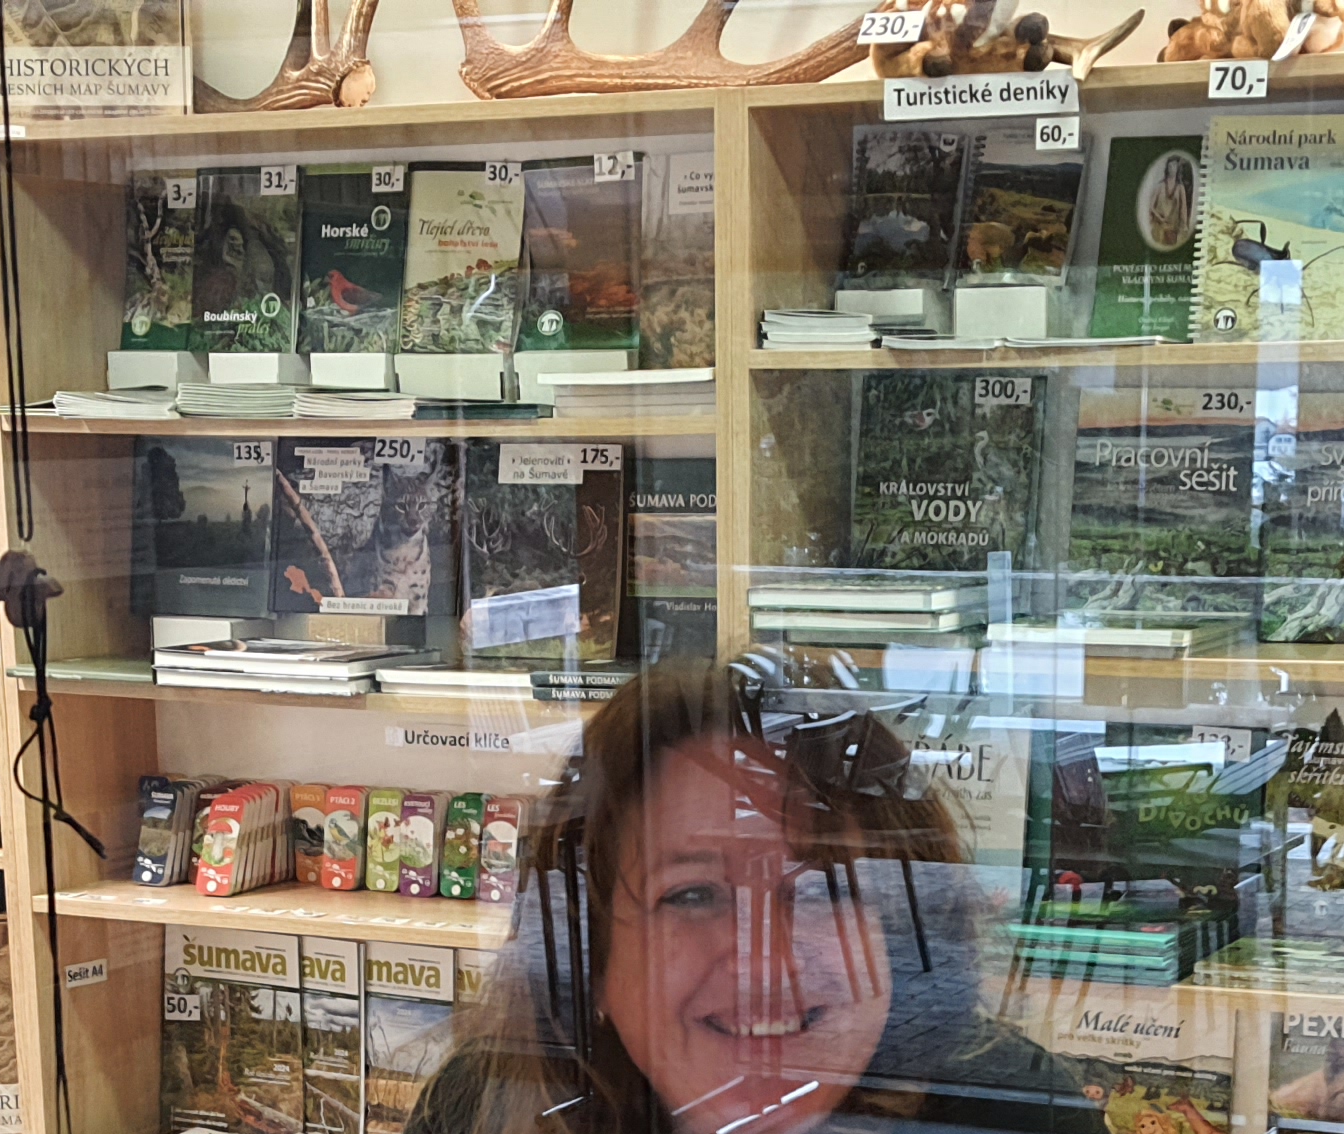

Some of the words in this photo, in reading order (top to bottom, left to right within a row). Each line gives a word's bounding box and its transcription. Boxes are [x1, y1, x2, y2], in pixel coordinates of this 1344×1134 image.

[861, 16, 919, 38] 230,-
[3, 54, 170, 78] HISTORICKÝCH
[106, 80, 170, 96] ŠUMAVY
[1214, 66, 1266, 95] 70,-
[893, 83, 992, 107] Turistické
[999, 80, 1069, 104] deníky
[1039, 125, 1074, 144] 60,-
[1225, 130, 1294, 147] Národní
[1298, 129, 1337, 149] park
[595, 155, 633, 179] 12,-
[1223, 148, 1311, 171] Šumava
[263, 171, 296, 192] 31,-
[374, 171, 401, 189] 30,-
[487, 164, 520, 185] 30,-
[321, 223, 368, 239] Horské
[978, 379, 1029, 402] 300,-
[1202, 393, 1252, 413] 230,-
[235, 444, 271, 464] 135,-
[376, 439, 423, 462] 250,-
[580, 448, 620, 468] 175,-
[1095, 440, 1210, 468] Pracovní
[879, 479, 970, 497] KRÁLOVSTVÍ
[1179, 464, 1238, 492] sešit
[629, 491, 686, 508] ŠUMAVA
[911, 500, 983, 522] VODY
[900, 532, 910, 544] A
[913, 529, 989, 546] MOKŘADŮ
[404, 730, 470, 748] Určovací
[474, 731, 510, 749] klíče
[183, 936, 287, 977] šumava
[67, 967, 89, 983] Sešit
[166, 996, 200, 1017] 50,-
[1077, 1009, 1131, 1034] Malé
[1133, 1016, 1185, 1039] učení
